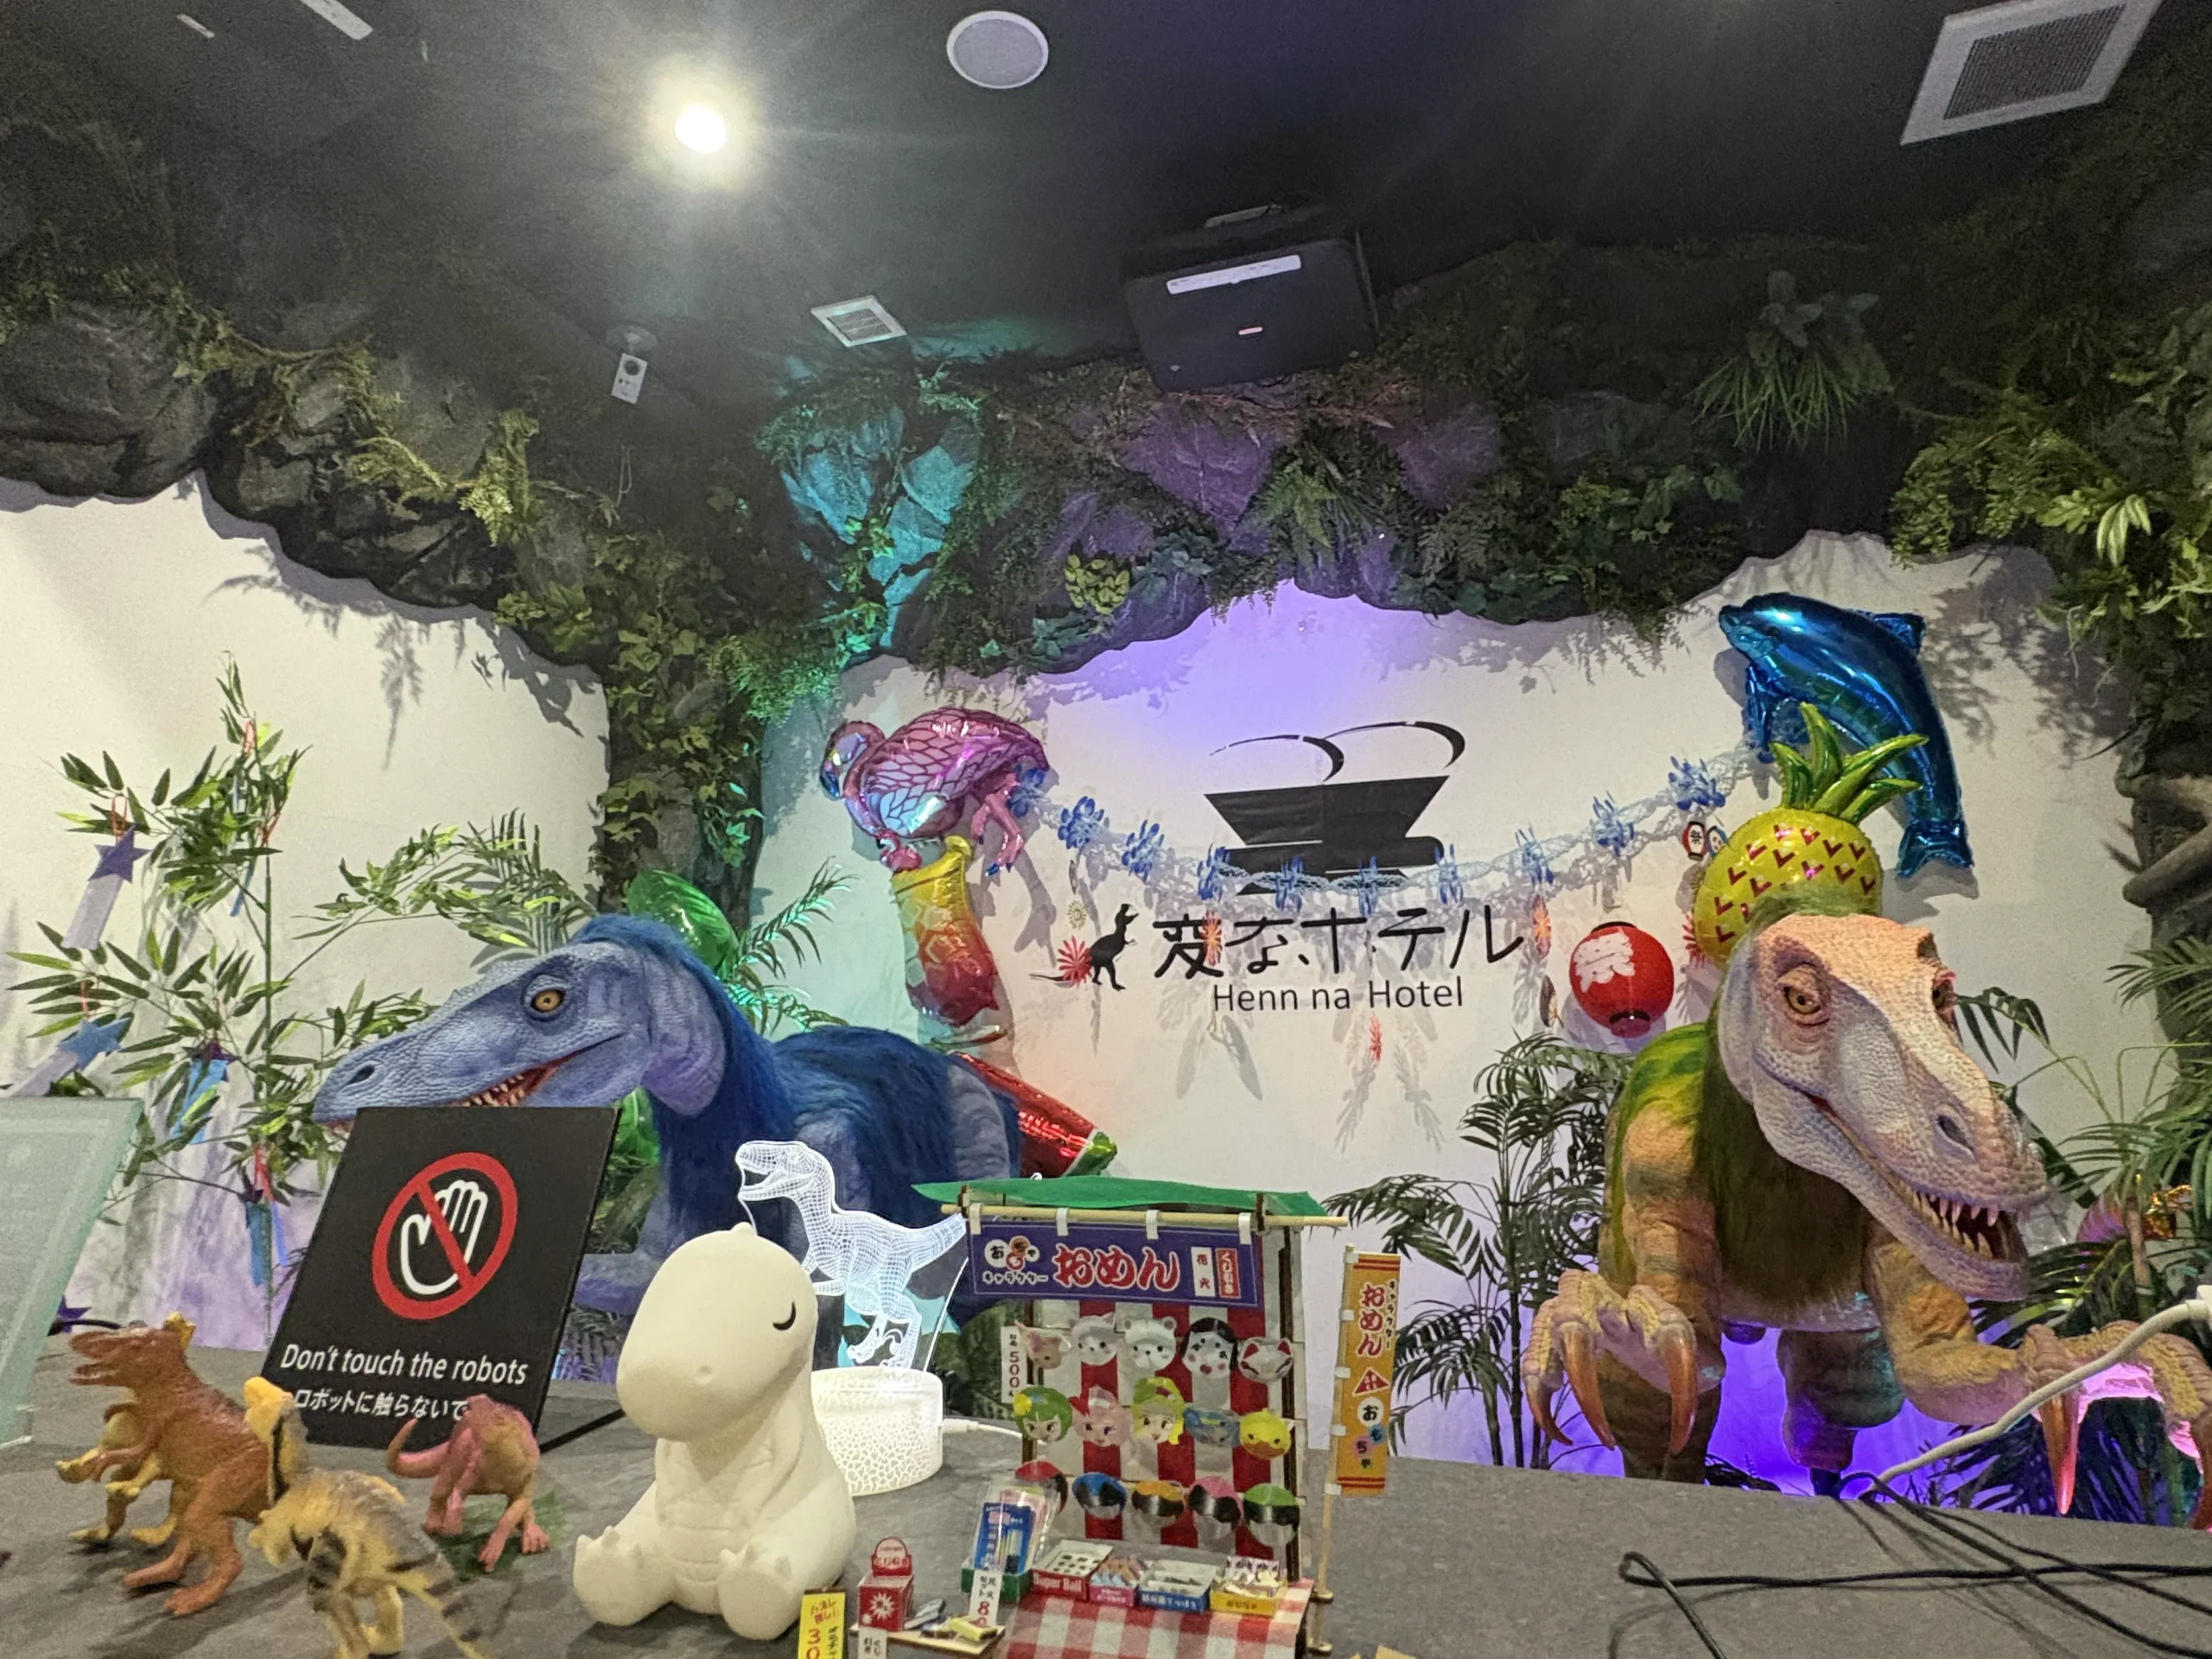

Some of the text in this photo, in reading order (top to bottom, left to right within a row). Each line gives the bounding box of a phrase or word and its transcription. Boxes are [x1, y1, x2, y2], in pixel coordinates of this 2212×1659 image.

[1213, 976, 1464, 1013] Henn na Hotel
[1052, 1243, 1180, 1292] おめん
[1357, 1282, 1386, 1357] おめん
[280, 1344, 529, 1384] Don't touch the robots
[295, 1388, 468, 1421] ロボットに触らないで
